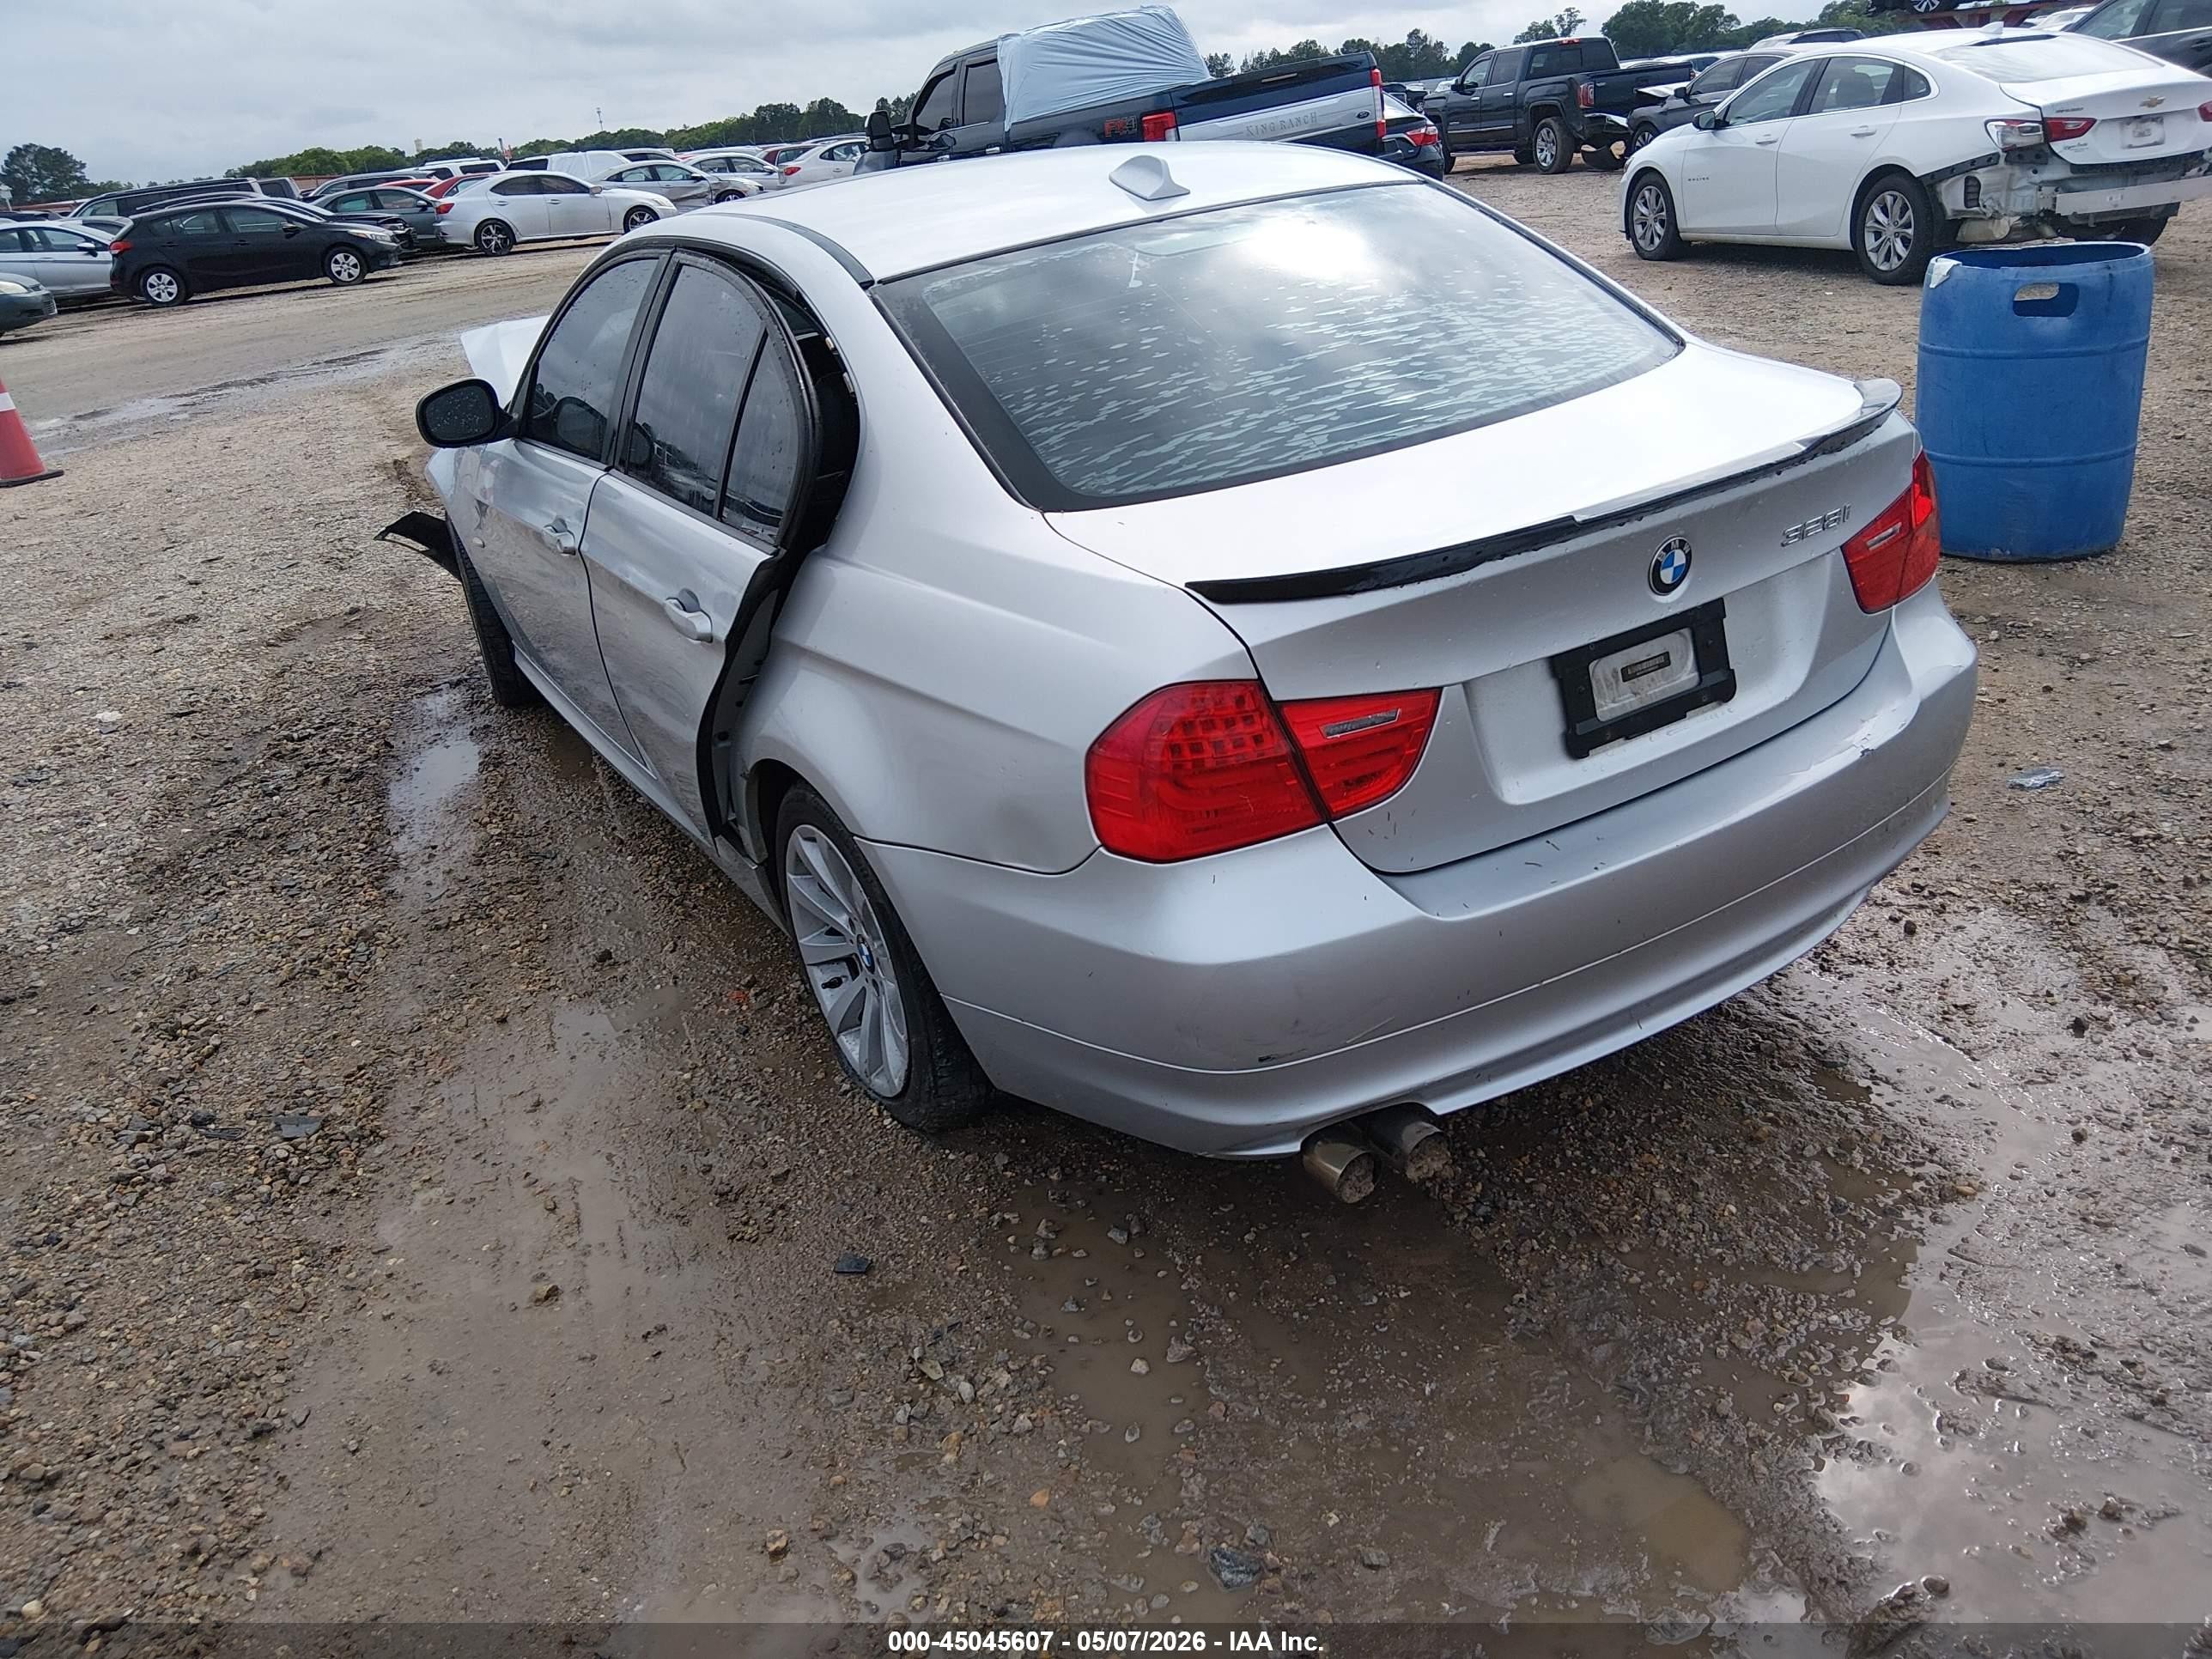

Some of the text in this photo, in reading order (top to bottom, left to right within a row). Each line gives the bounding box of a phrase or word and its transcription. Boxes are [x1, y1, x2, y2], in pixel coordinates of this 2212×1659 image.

[1103, 115, 1137, 137] FX4
[1245, 111, 1318, 138] KING RANCH
[1780, 501, 1851, 547] 328i
[1657, 539, 1691, 562] BMW
